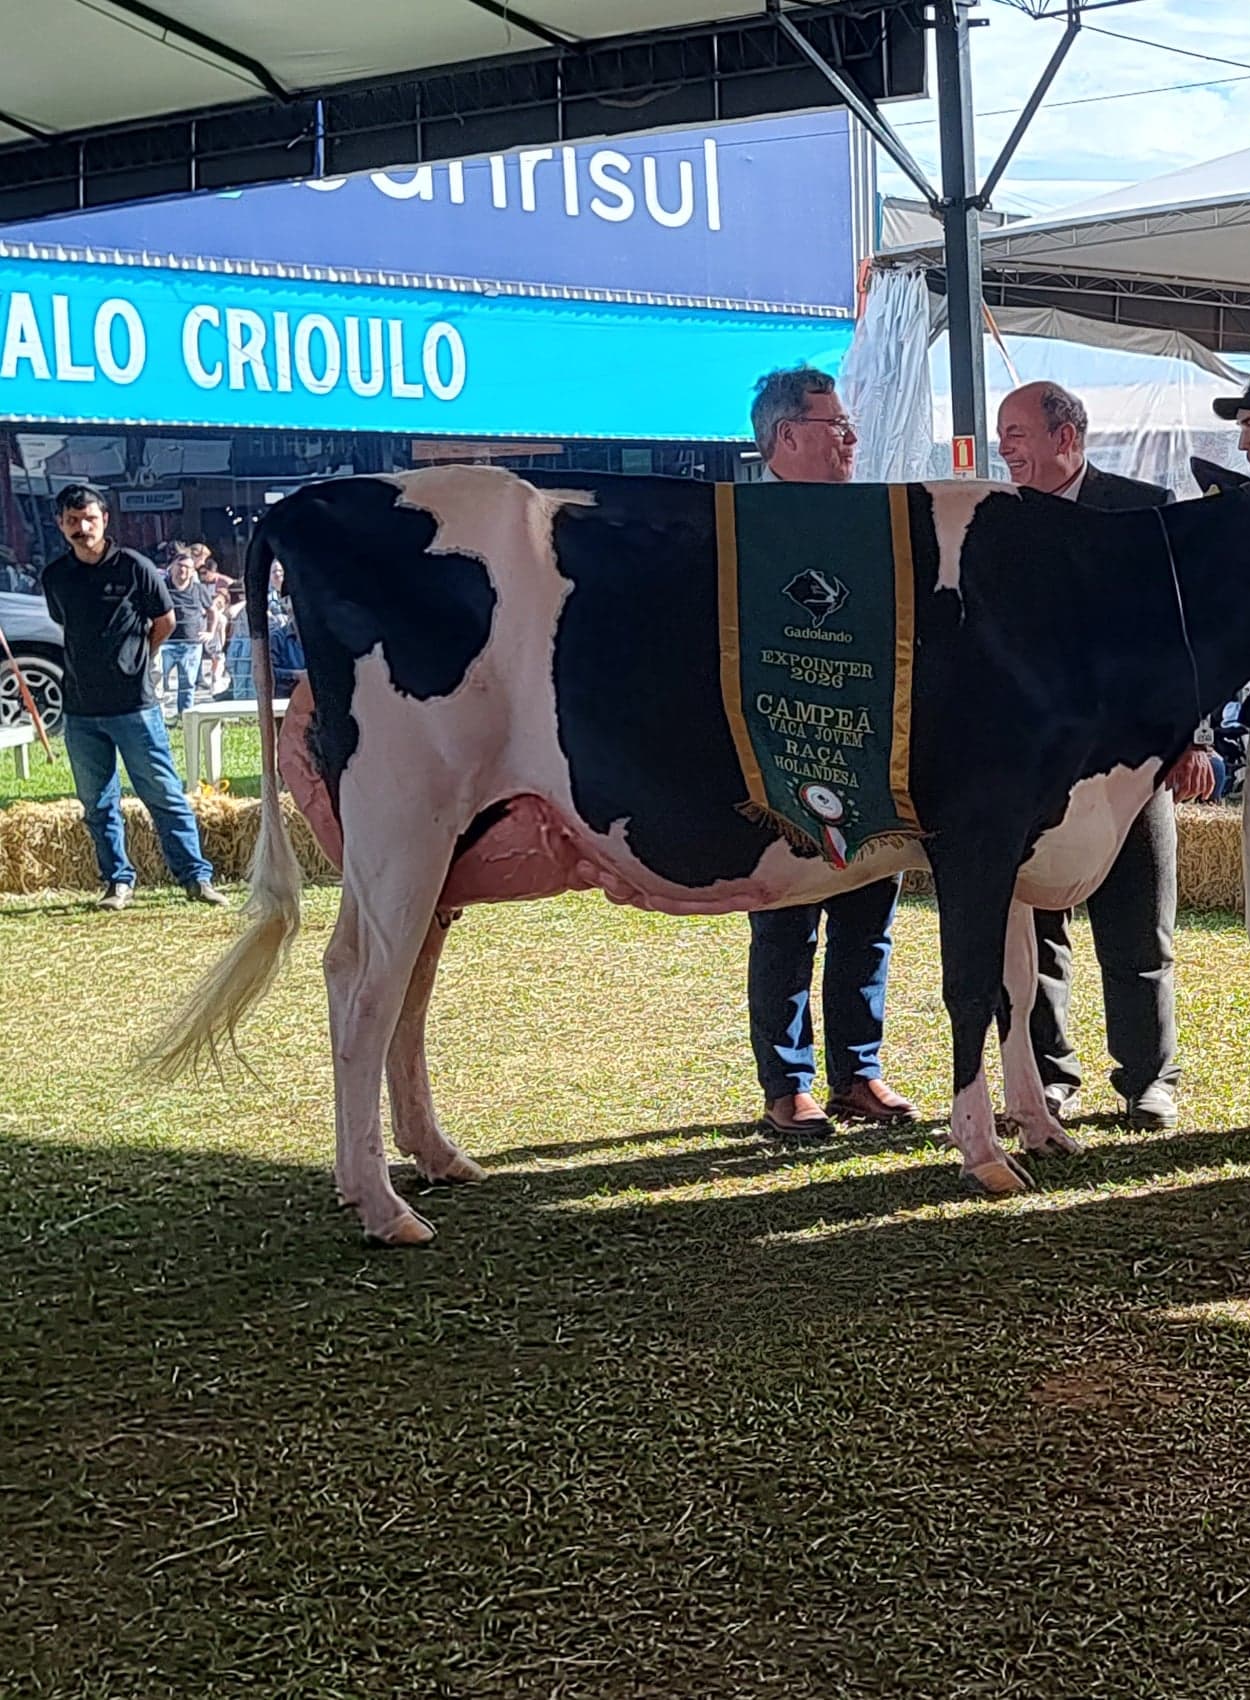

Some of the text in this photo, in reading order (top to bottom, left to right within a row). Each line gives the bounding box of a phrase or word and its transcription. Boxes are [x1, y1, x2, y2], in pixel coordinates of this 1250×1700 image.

[1, 292, 467, 401] ALO CRIOULO
[784, 626, 853, 643] Gadolando
[761, 649, 873, 679] EXPOINTER
[790, 667, 843, 688] 2026
[756, 693, 874, 734] CAMPEÃ
[768, 715, 863, 748] VACA JOVEM
[785, 738, 847, 765] RAÇA
[774, 755, 859, 788] HOLANDESA
